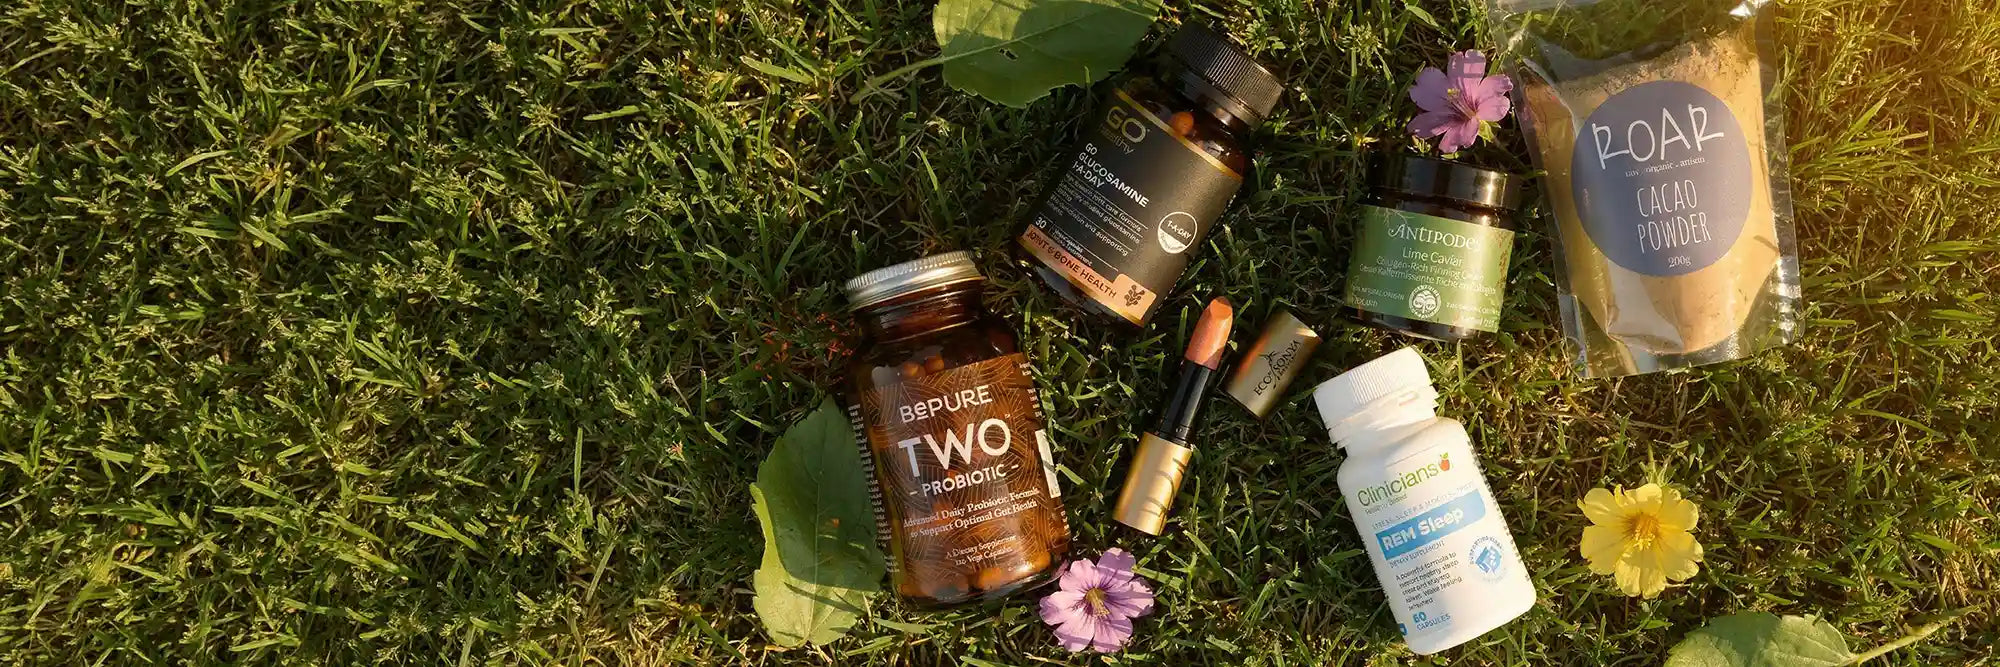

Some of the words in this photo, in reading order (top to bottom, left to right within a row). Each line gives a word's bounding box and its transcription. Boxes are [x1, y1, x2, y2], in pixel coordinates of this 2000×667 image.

[1107, 106, 1146, 143] GO
[1592, 103, 1724, 170] ROAR
[1085, 142, 1098, 156] GO
[1078, 152, 1150, 208] GLUCOSAMINE
[1637, 179, 1698, 218] CACAO
[1035, 216, 1047, 229] 30
[1637, 212, 1712, 254] POWDER
[1027, 230, 1049, 249] JOINT
[1054, 251, 1080, 273] BONE
[1080, 269, 1117, 298] HEALTH
[1402, 247, 1428, 261] Lime
[1430, 252, 1464, 267] Caviar
[1668, 255, 1692, 268] 200g
[1253, 375, 1272, 396] ECO
[1272, 340, 1300, 371] SONYA
[897, 418, 1012, 478] TWO
[921, 464, 1007, 497] PROBIOTIC
[1357, 463, 1440, 507] Clinicians
[954, 512, 993, 529] Optimal
[1382, 526, 1417, 551] REM
[1418, 507, 1464, 536] Sleep
